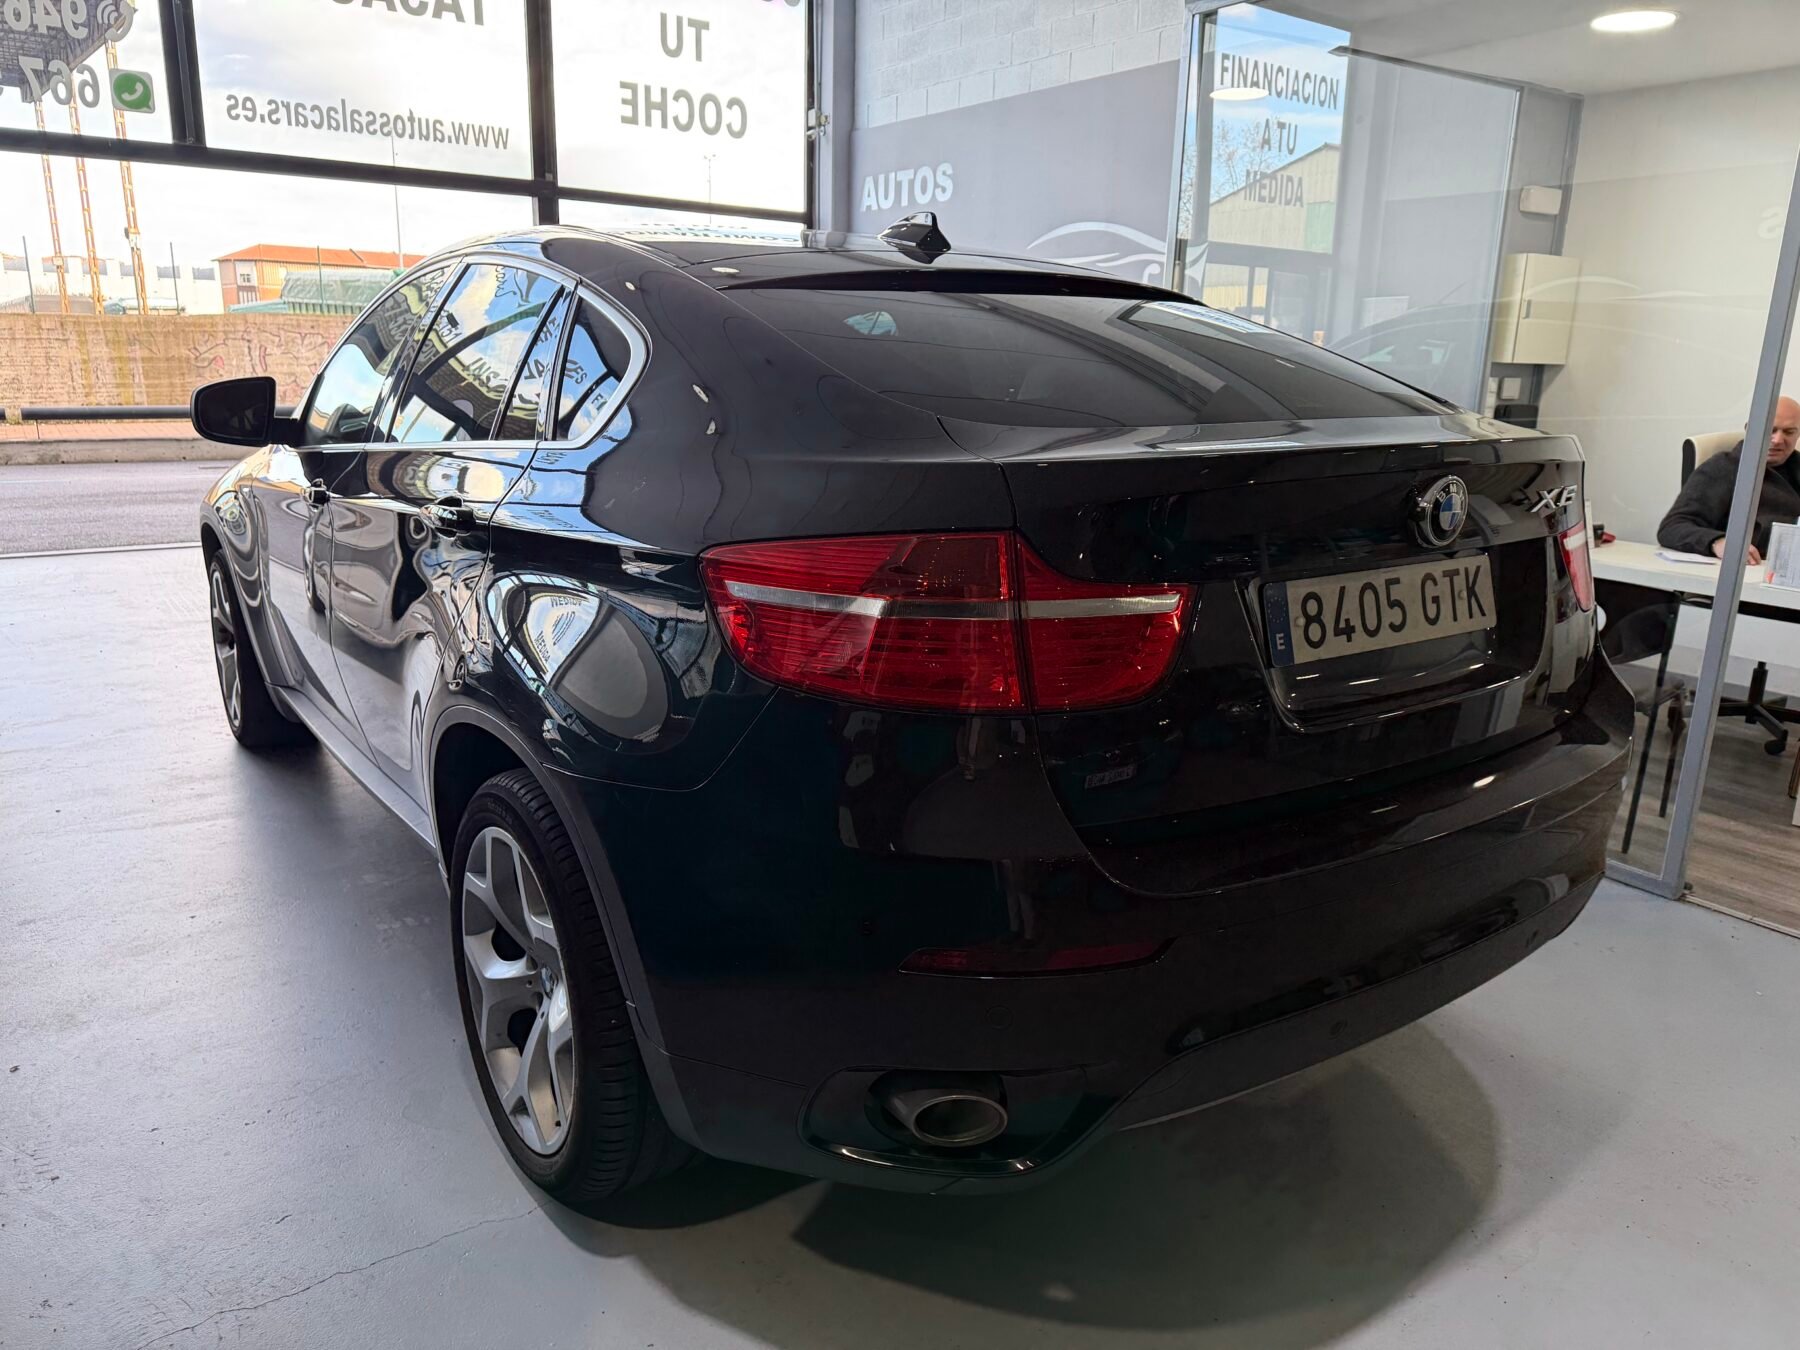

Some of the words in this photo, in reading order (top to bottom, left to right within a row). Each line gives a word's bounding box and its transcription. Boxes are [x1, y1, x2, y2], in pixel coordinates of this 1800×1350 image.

[1220, 52, 1340, 110] FINANCIACION
[1261, 118, 1272, 152] A
[1277, 120, 1299, 155] TU
[861, 162, 954, 213] AUTOS
[1244, 169, 1305, 208] MEDIDA
[1300, 576, 1408, 650] 8405
[1420, 564, 1487, 627] GTK
[1275, 632, 1286, 651] E
